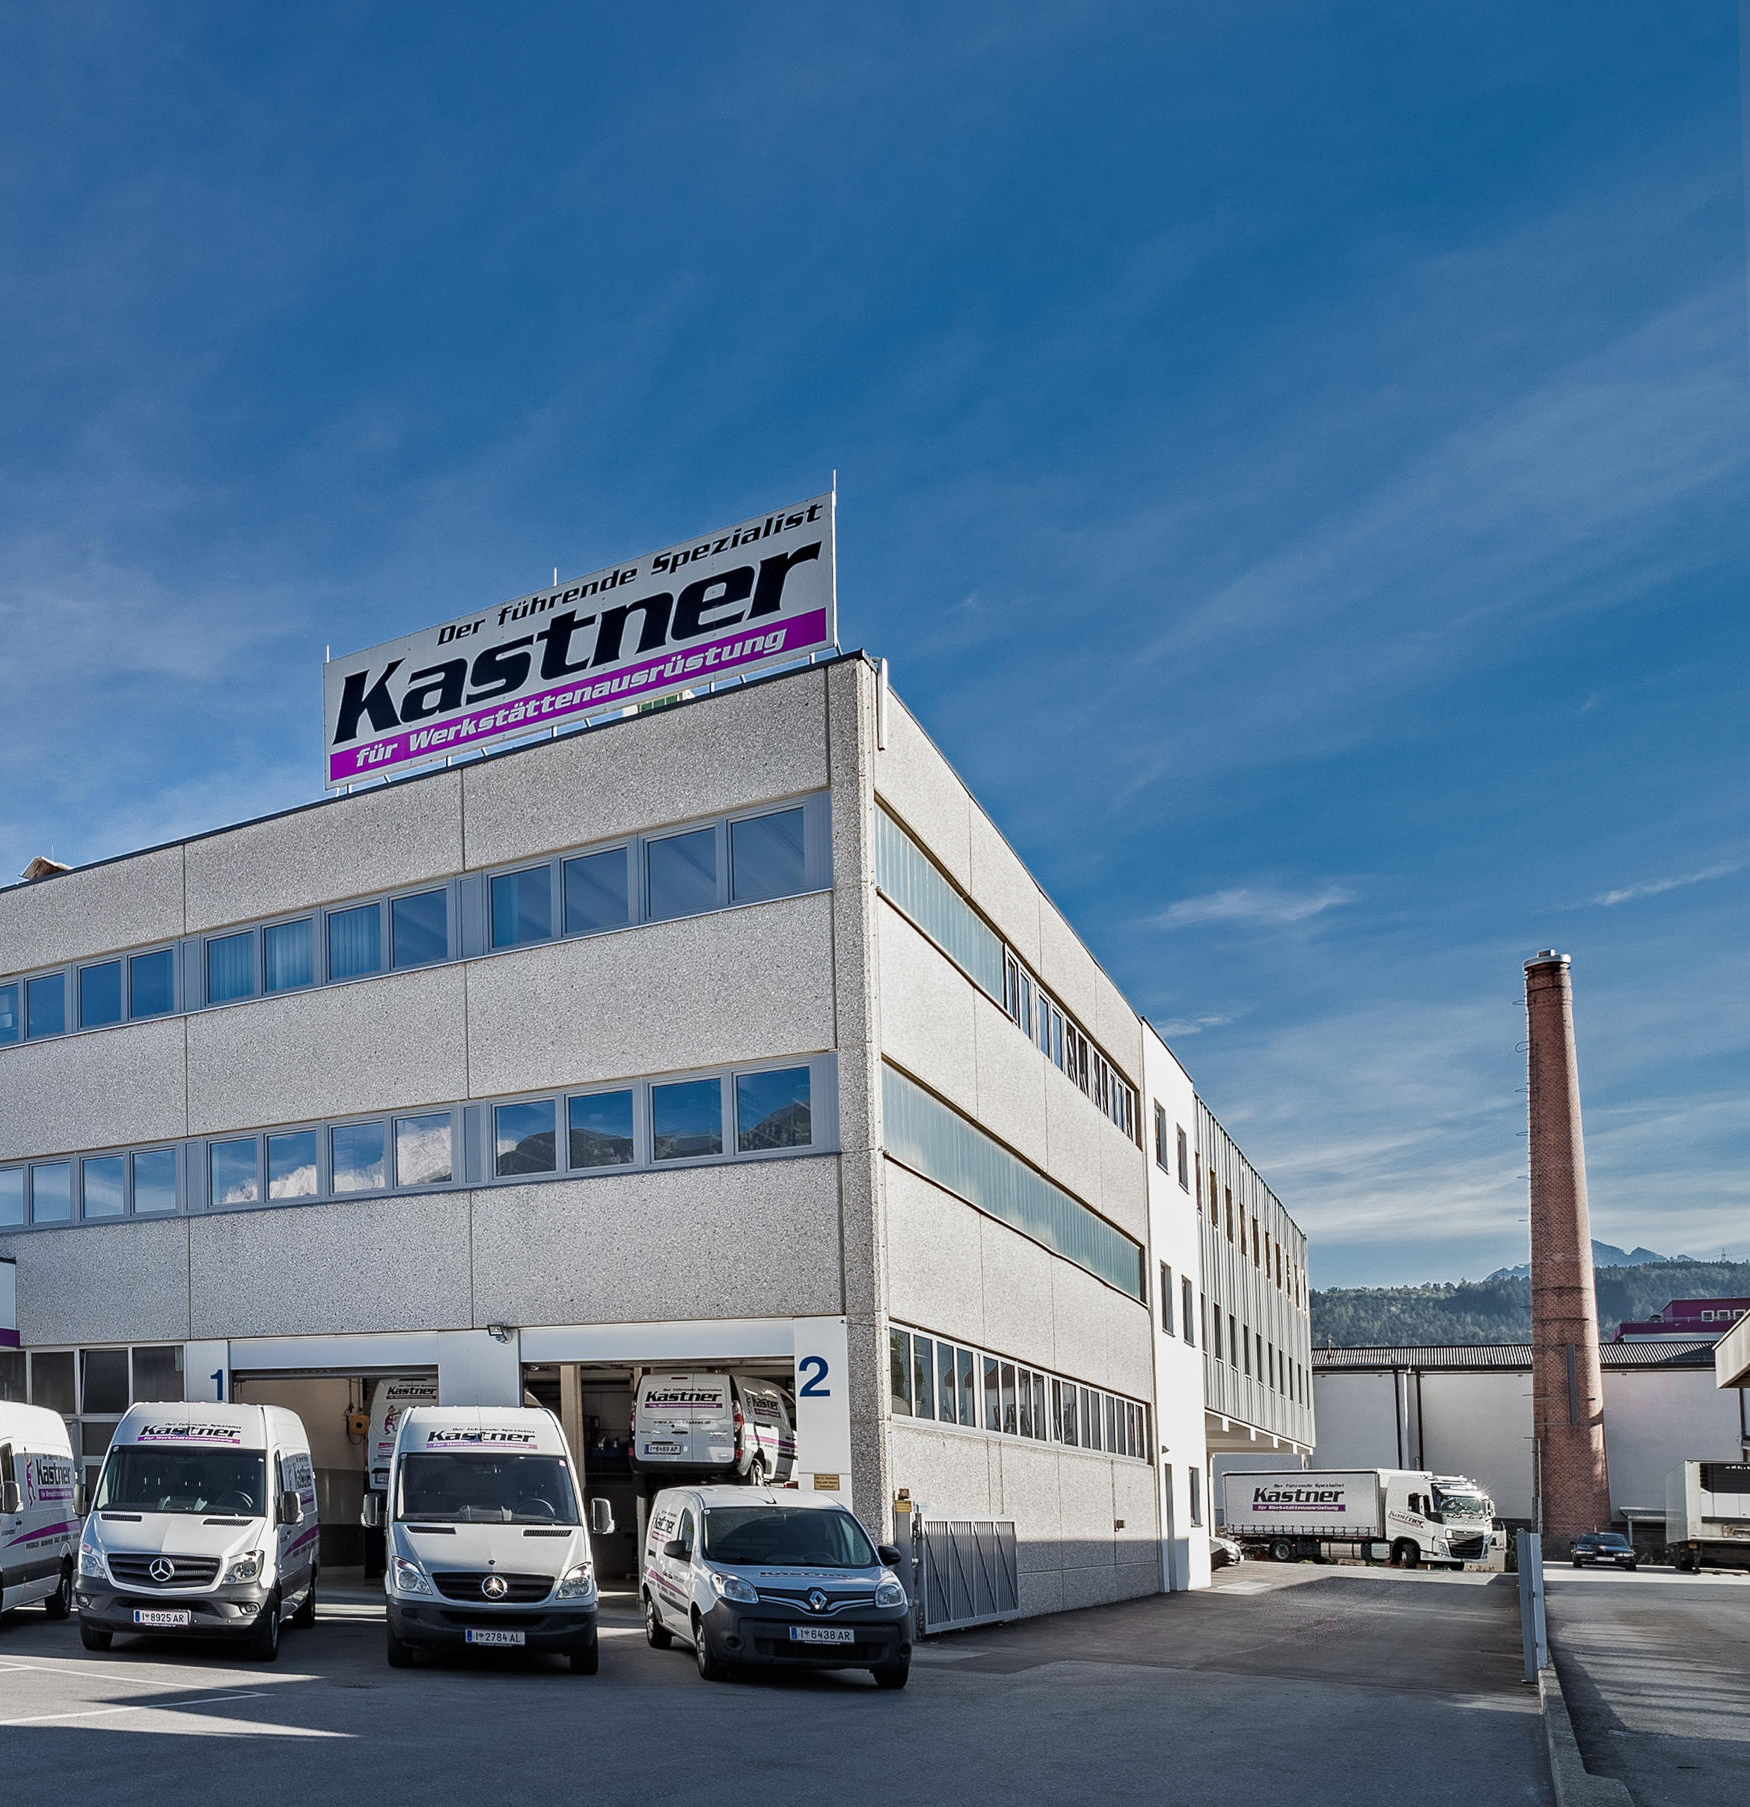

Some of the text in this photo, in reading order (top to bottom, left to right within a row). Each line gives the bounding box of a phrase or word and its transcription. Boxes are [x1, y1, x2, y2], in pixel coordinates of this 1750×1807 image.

[437, 503, 823, 646] Der führende Spezialist
[332, 541, 821, 745] Kastner
[356, 628, 787, 768] für Werkstättenausrüstung
[799, 1356, 830, 1397] 2
[211, 1369, 223, 1401] 1
[387, 1386, 437, 1395] Kastner
[645, 1391, 722, 1402] Kastner
[139, 1425, 241, 1437] Kastner
[427, 1430, 536, 1442] Kastner
[35, 1459, 71, 1485] Kastner
[1253, 1488, 1344, 1503] Kastner
[150, 1613, 171, 1622] 8925
[173, 1614, 184, 1623] AR
[485, 1632, 507, 1642] 2784
[509, 1633, 521, 1643] AL
[811, 1630, 836, 1640] 6438
[837, 1631, 851, 1641] AR
